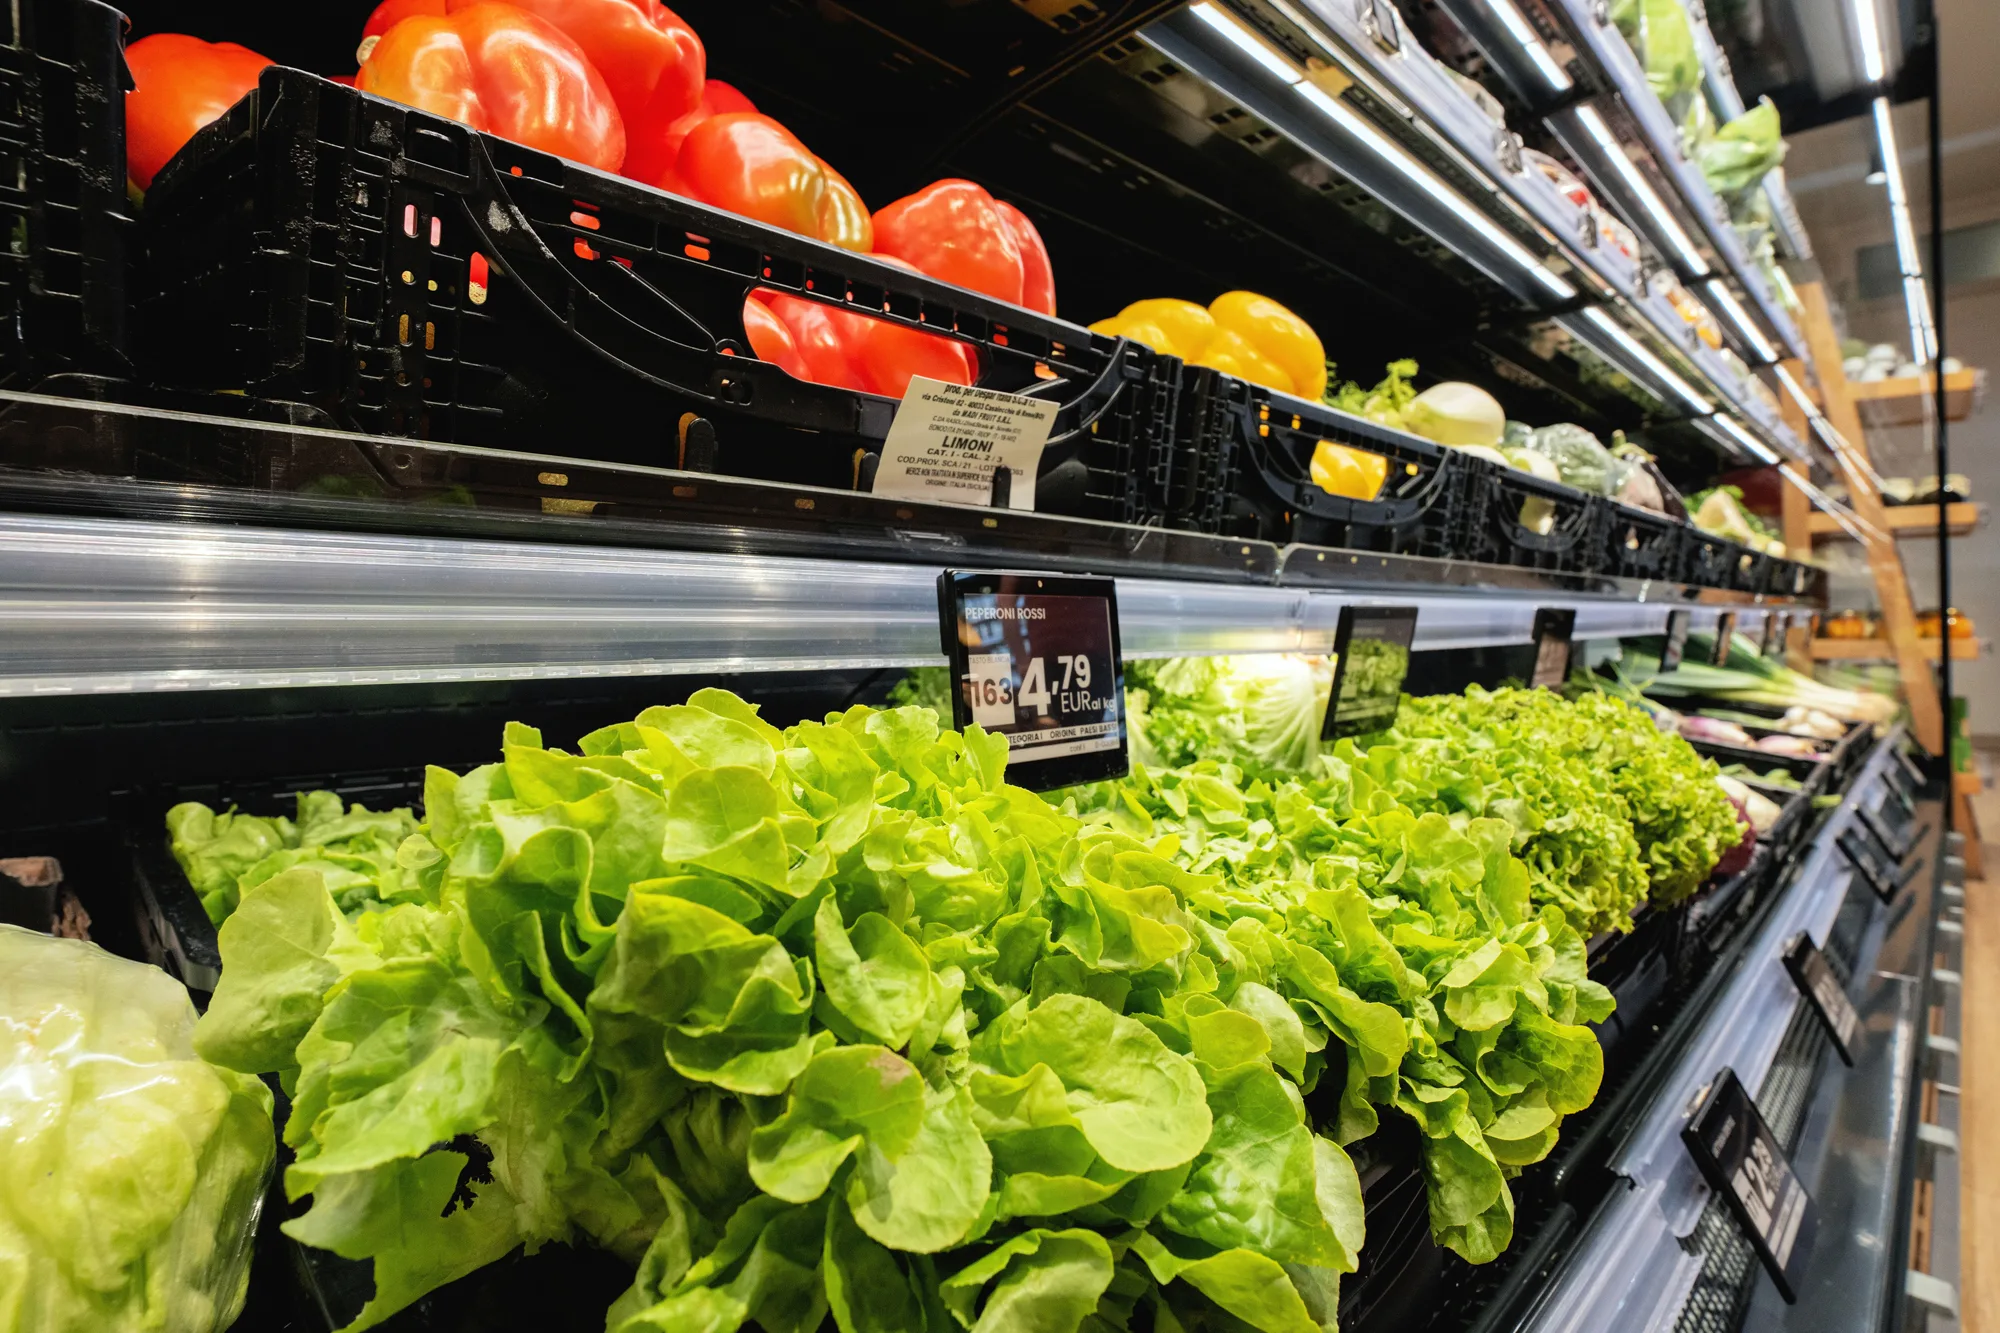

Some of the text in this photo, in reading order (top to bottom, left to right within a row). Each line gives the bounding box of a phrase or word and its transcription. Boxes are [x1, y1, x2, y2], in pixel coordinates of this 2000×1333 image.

[922, 393, 931, 401] via
[943, 384, 962, 394] prod.
[962, 388, 974, 398] per
[942, 435, 993, 453] LIMONI
[927, 448, 948, 457] CAT.
[962, 452, 981, 460] CAL.
[965, 607, 1046, 619] PEPERONI ROSSI
[971, 677, 1012, 707] 163
[1007, 733, 1039, 744] TEGORIA
[1050, 728, 1076, 739] ORIGINE
[1080, 726, 1098, 735] PAESI
